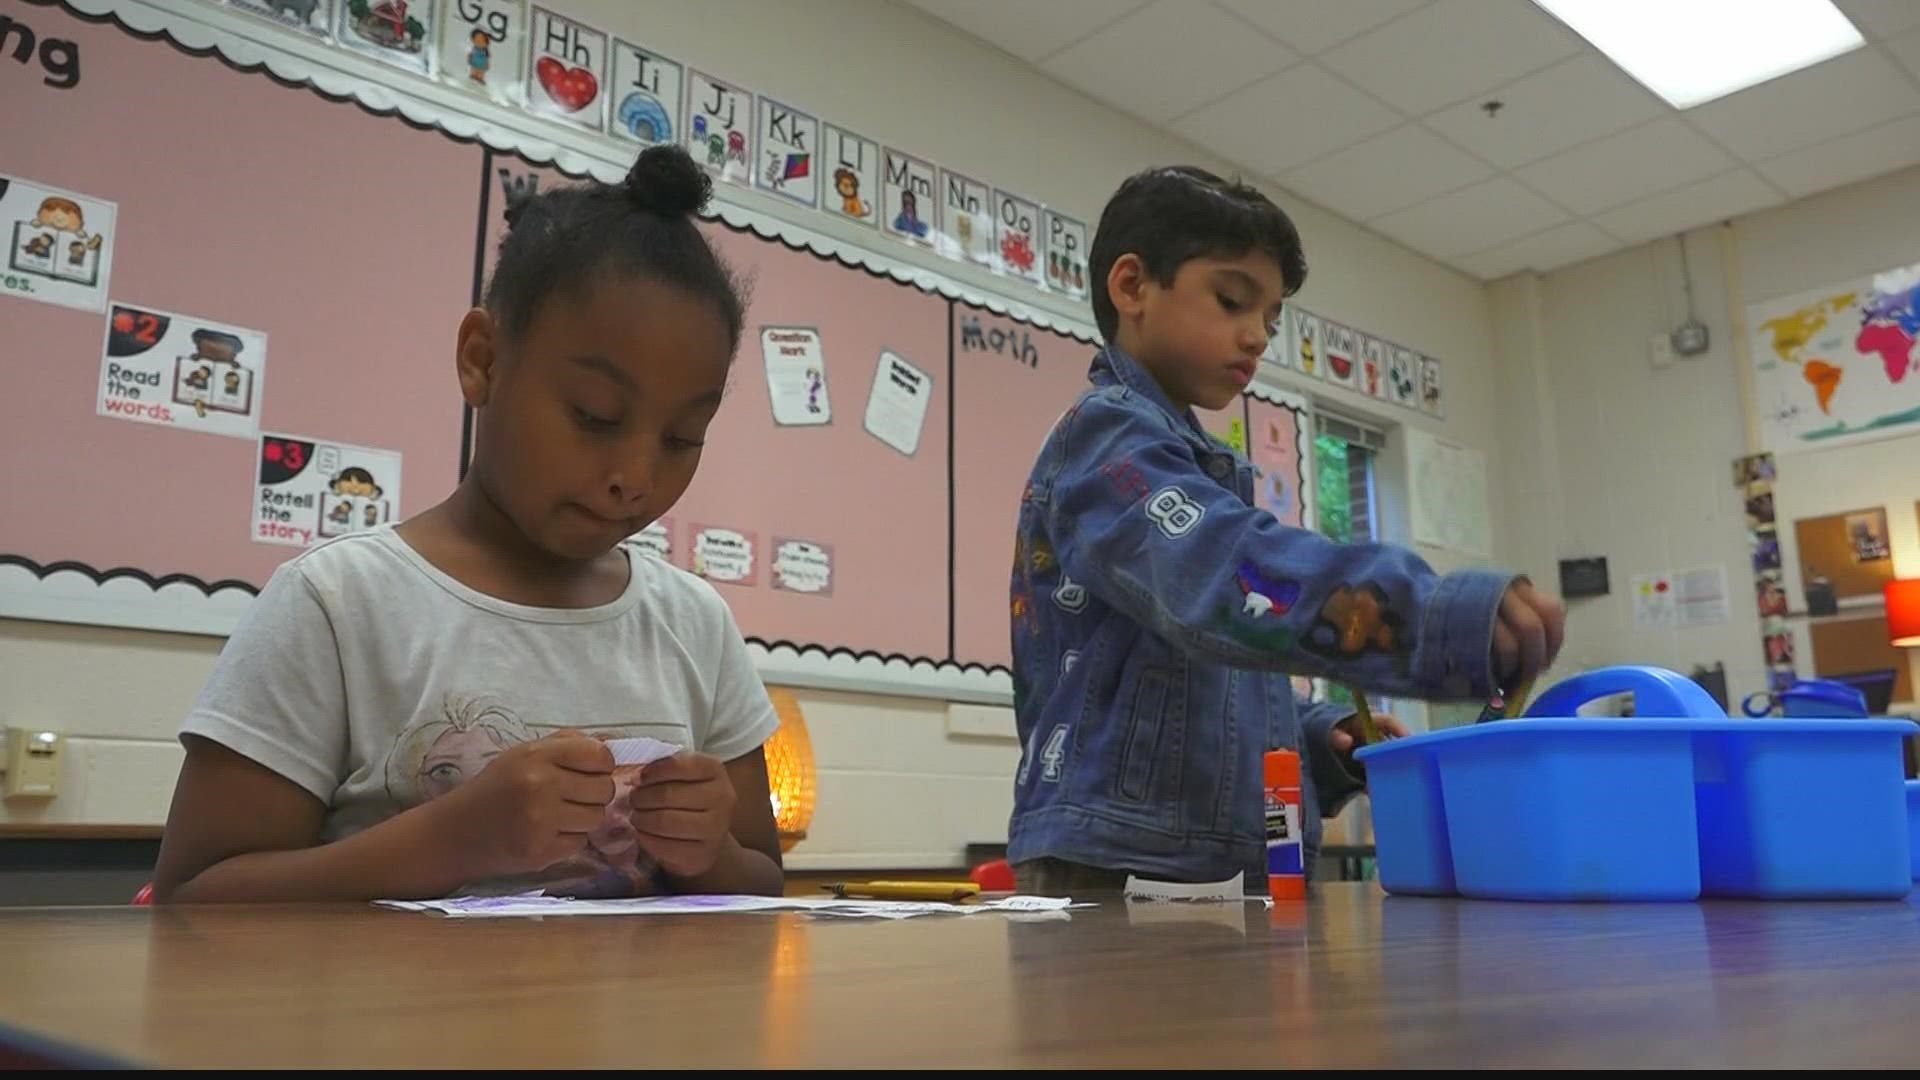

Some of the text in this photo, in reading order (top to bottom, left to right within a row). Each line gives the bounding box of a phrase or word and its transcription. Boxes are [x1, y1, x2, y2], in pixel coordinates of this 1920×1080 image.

[545, 16, 591, 67] Hh
[632, 52, 660, 95] Ii
[703, 83, 736, 129] Jj
[768, 106, 806, 150] Kk
[838, 134, 863, 172] Ll
[886, 153, 932, 198] Mm
[949, 178, 980, 214] Nn
[0, 273, 34, 293] es.
[961, 315, 1038, 369] Math
[107, 379, 141, 399] the
[108, 362, 161, 387] Read
[105, 398, 174, 422] words.
[261, 488, 314, 509] Retell
[261, 505, 291, 522] the
[1146, 486, 1205, 539] 8
[1041, 724, 1071, 782] 4
